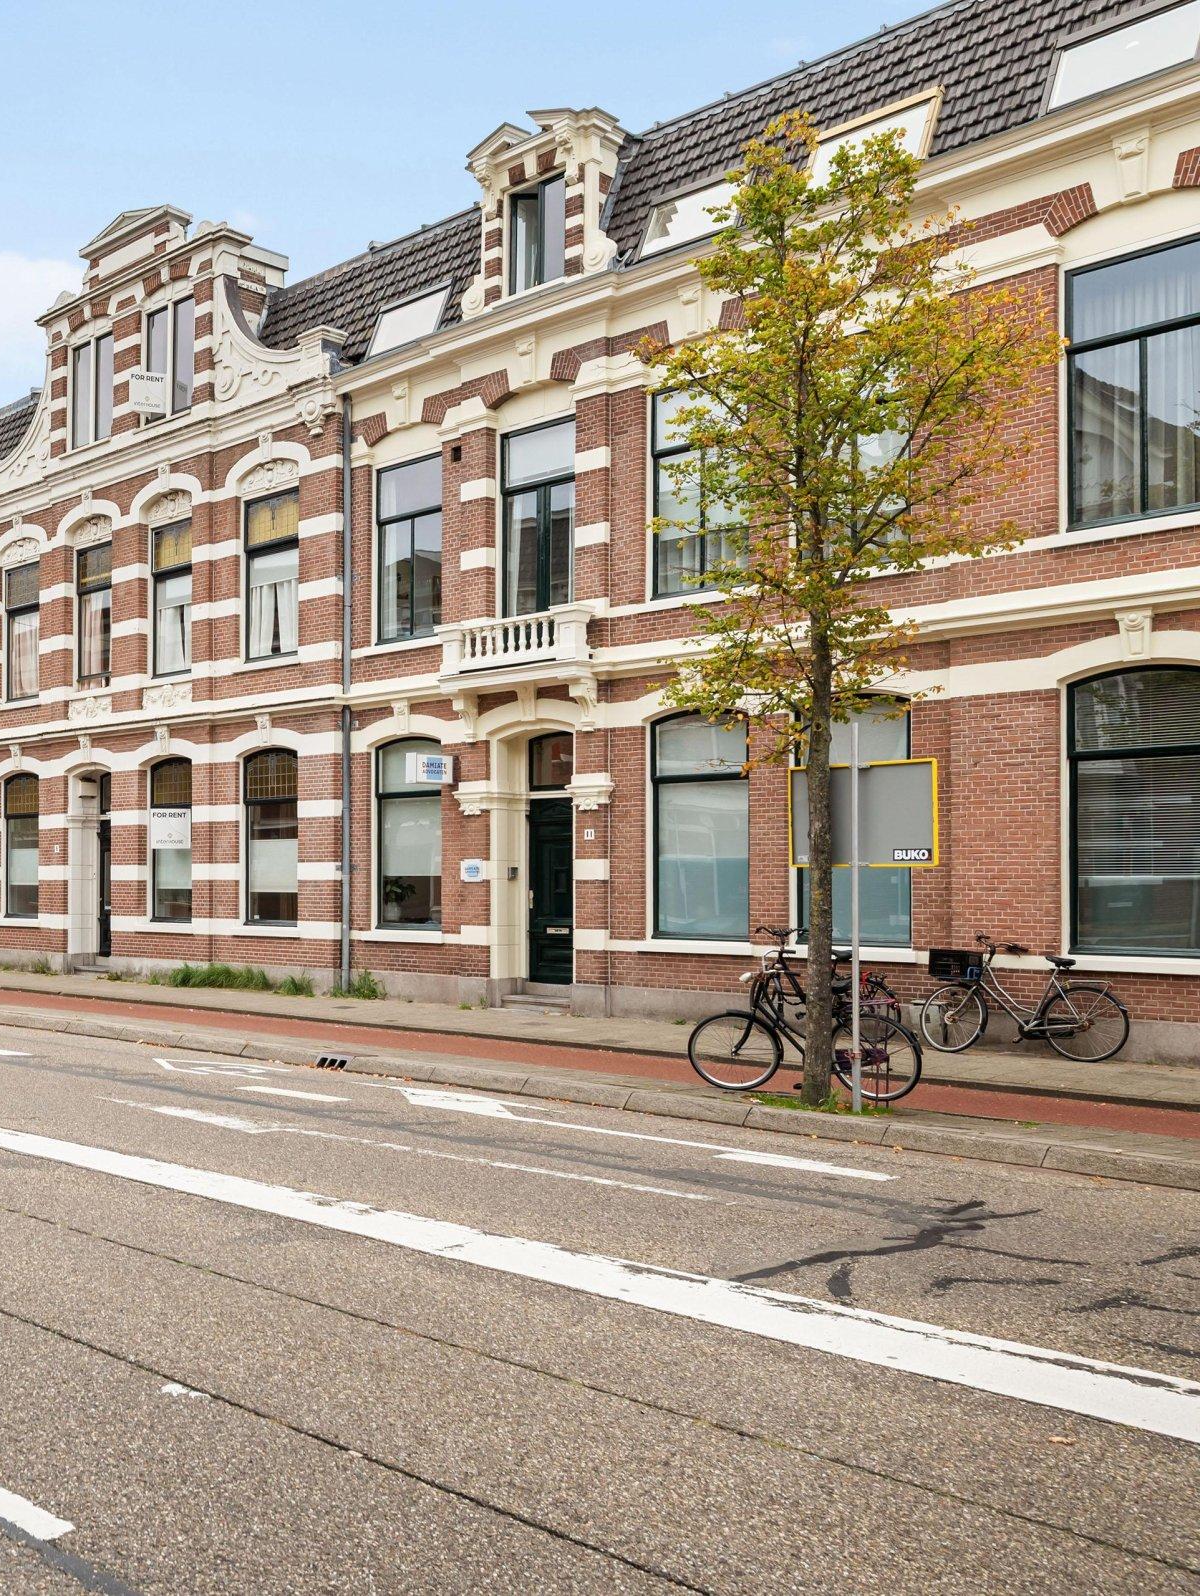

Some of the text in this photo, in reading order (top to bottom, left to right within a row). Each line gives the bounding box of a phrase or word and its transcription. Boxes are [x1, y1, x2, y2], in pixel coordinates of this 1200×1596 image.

[130, 373, 145, 381] FOR
[421, 762, 447, 770] DAMIATE
[586, 830, 593, 838] 11
[893, 849, 929, 860] BUKO
